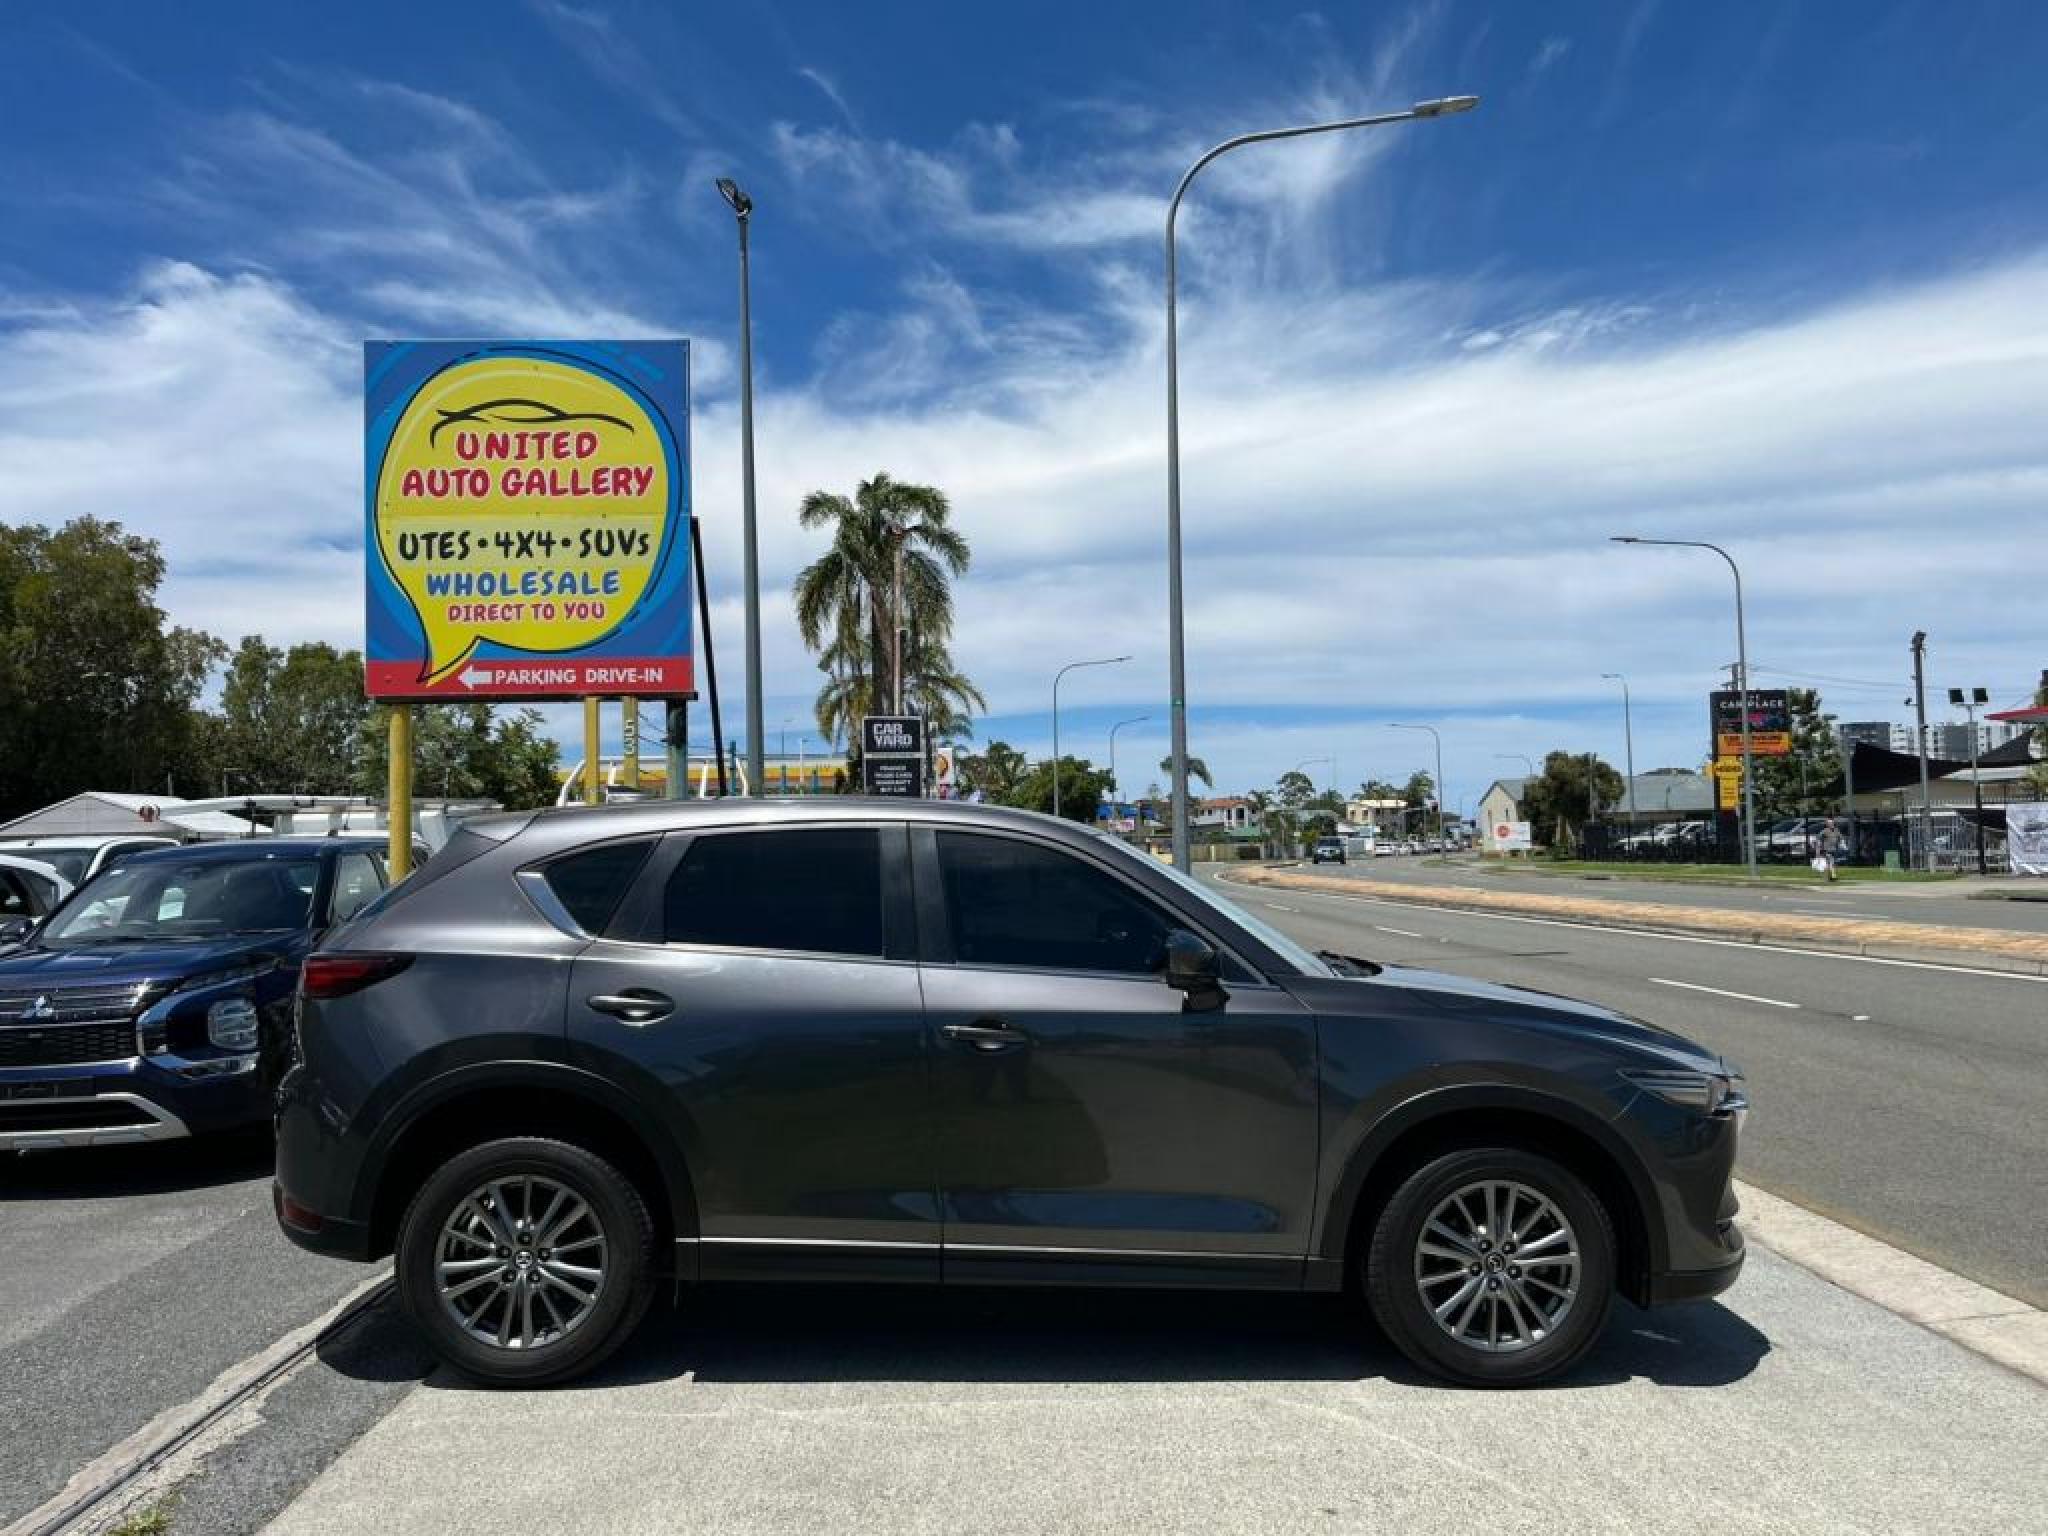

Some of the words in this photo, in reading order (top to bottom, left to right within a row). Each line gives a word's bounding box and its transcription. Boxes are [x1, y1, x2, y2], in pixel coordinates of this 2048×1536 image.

[456, 431, 598, 460] UNITED
[402, 467, 490, 498] AUTO
[501, 466, 654, 498] GALLERY
[399, 531, 470, 561] UTES
[495, 529, 556, 559] 4X4
[579, 528, 650, 558] SUVs
[426, 571, 620, 597] WHOLESALE
[448, 603, 523, 622] DIRECT
[531, 603, 554, 621] TO
[563, 602, 605, 620] YOU
[495, 670, 576, 685] PARKING
[585, 667, 663, 683] DRIVE-IN
[873, 723, 903, 735] CAR
[874, 734, 913, 747] YARD
